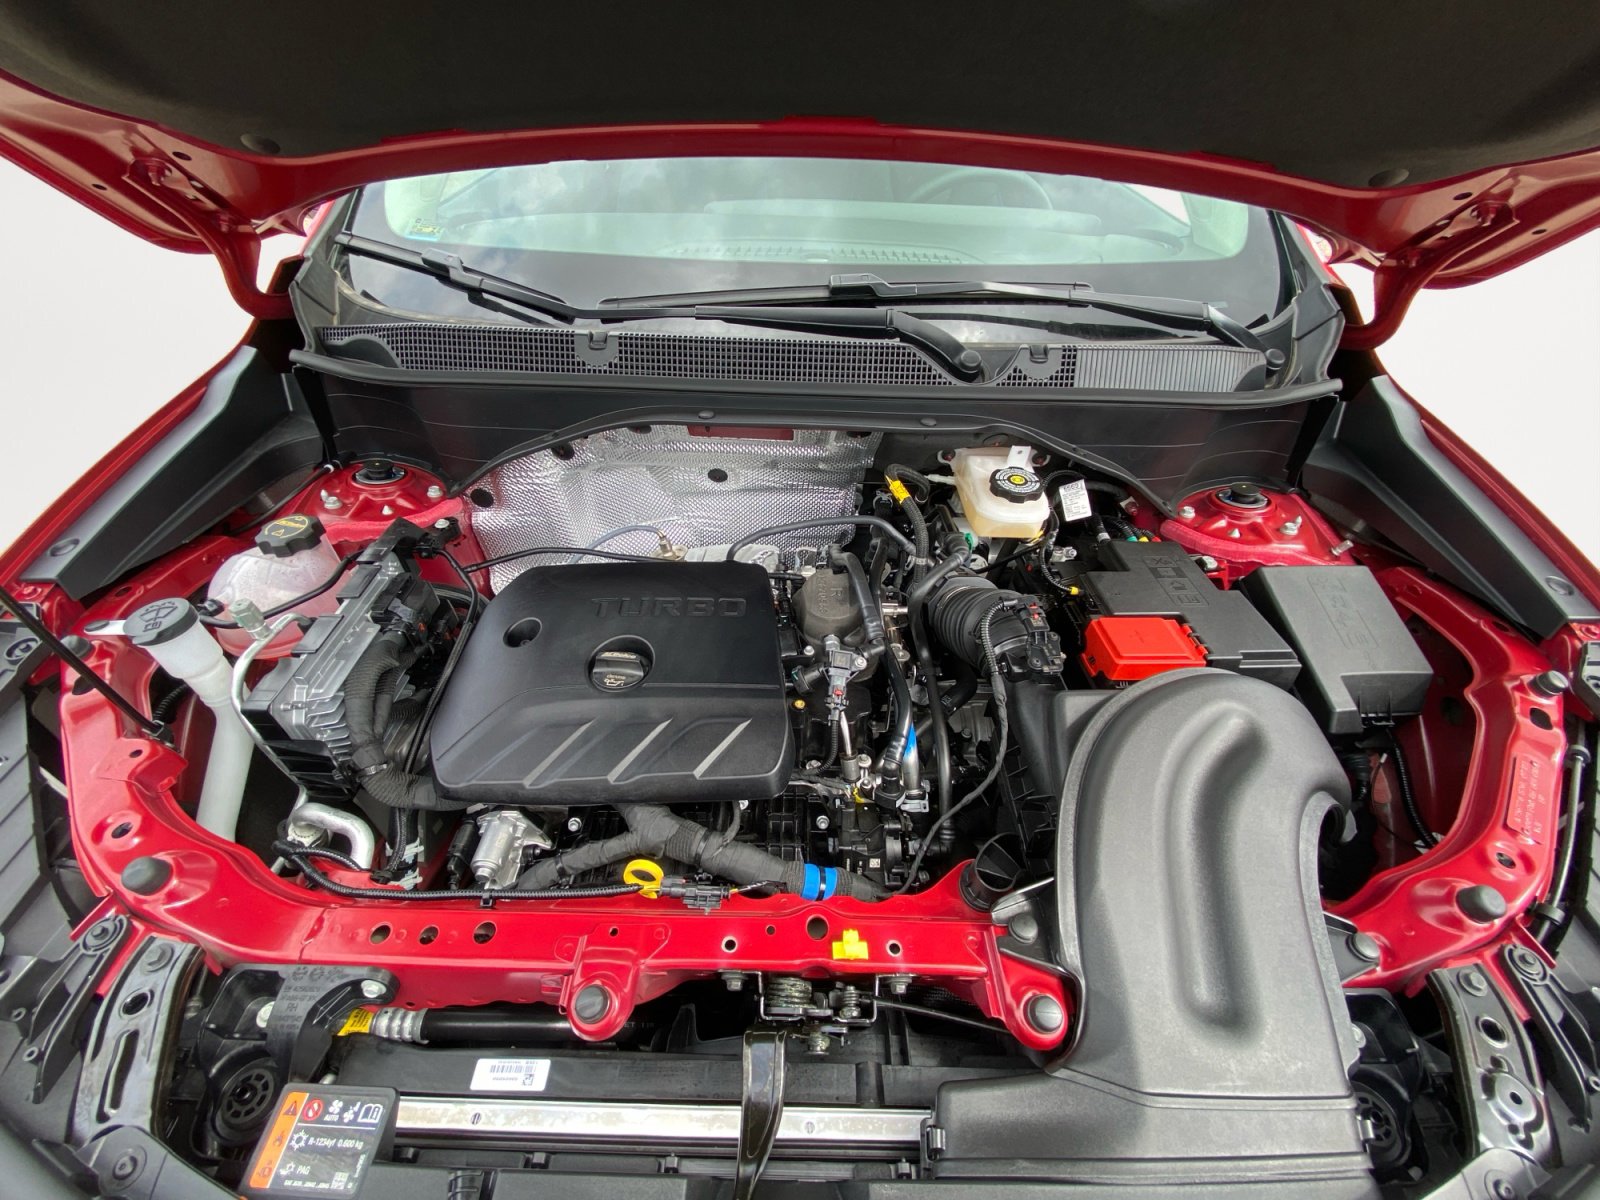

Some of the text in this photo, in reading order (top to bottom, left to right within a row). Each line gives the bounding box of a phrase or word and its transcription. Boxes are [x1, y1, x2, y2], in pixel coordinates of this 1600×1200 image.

[592, 597, 747, 618] TURBO
[355, 1140, 364, 1149] kg
[297, 1164, 310, 1175] PAG
